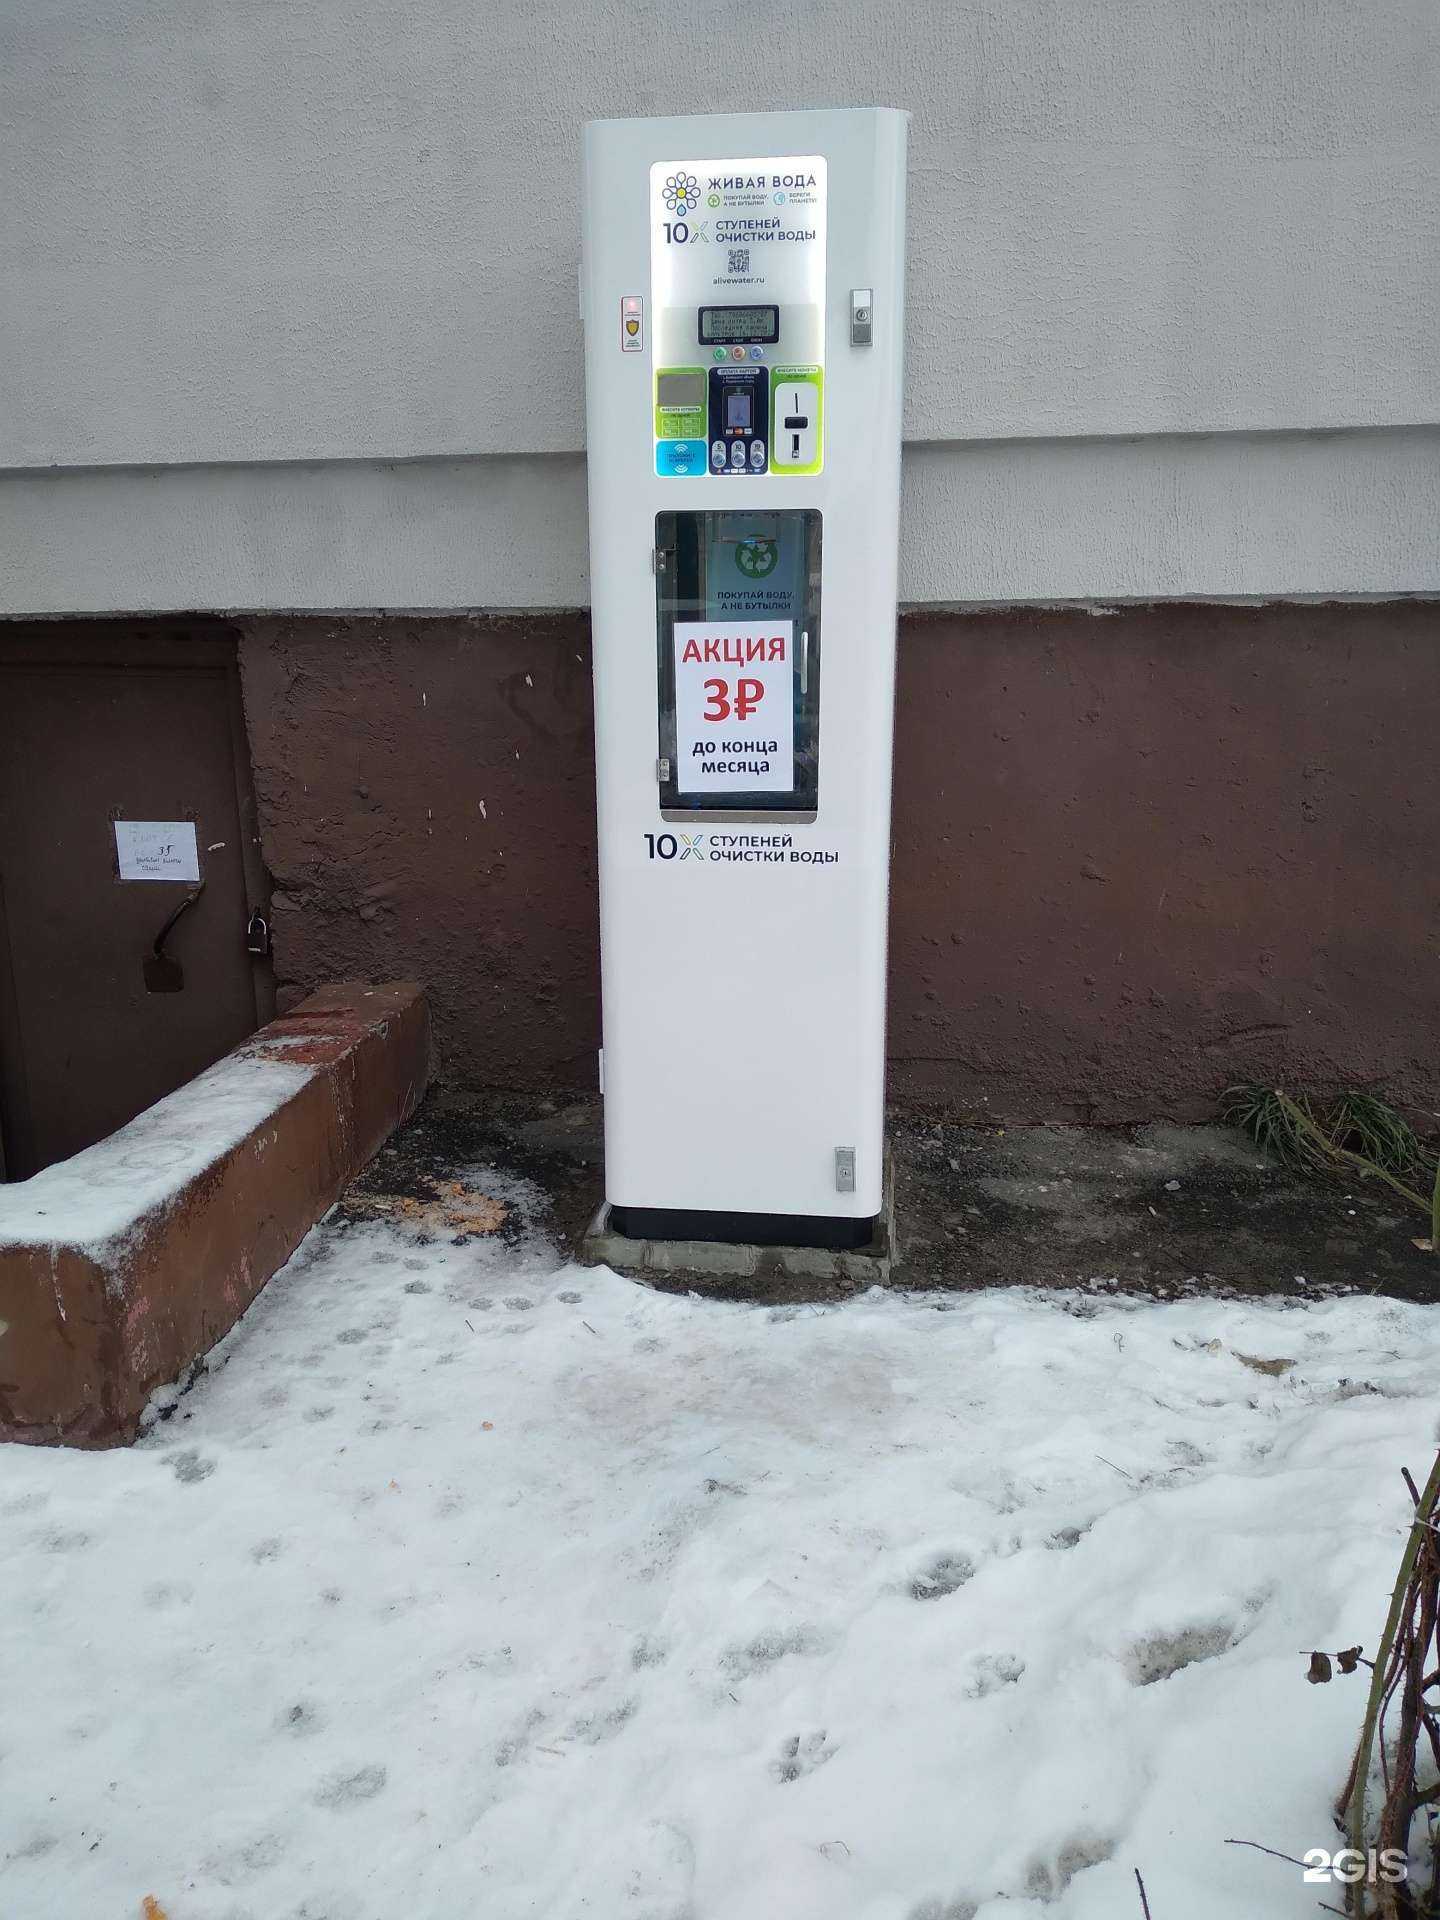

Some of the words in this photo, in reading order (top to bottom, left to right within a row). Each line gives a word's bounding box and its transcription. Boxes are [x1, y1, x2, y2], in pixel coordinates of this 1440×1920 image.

[708, 177, 766, 190] ЖИВАЯ
[772, 174, 817, 188] ВОДА
[715, 217, 780, 230] СТУПЕНЕЙ
[715, 231, 774, 243] ОЧИСТКИ
[778, 230, 816, 242] ВОДЫ
[713, 276, 765, 285] alivewater.ru
[717, 590, 764, 599] ПОКУПАЙ
[721, 602, 728, 610] А
[730, 602, 743, 610] НЕ
[745, 602, 792, 610] БУТЫЛКИ
[682, 637, 785, 667] АКЦИЯ
[692, 741, 716, 756] до
[722, 740, 778, 755] конца
[701, 760, 770, 775] месяца
[710, 834, 793, 847] СТУПЕНЕЙ
[710, 850, 785, 862] ОЧИСТКИ
[790, 851, 839, 864] ВОДЫ
